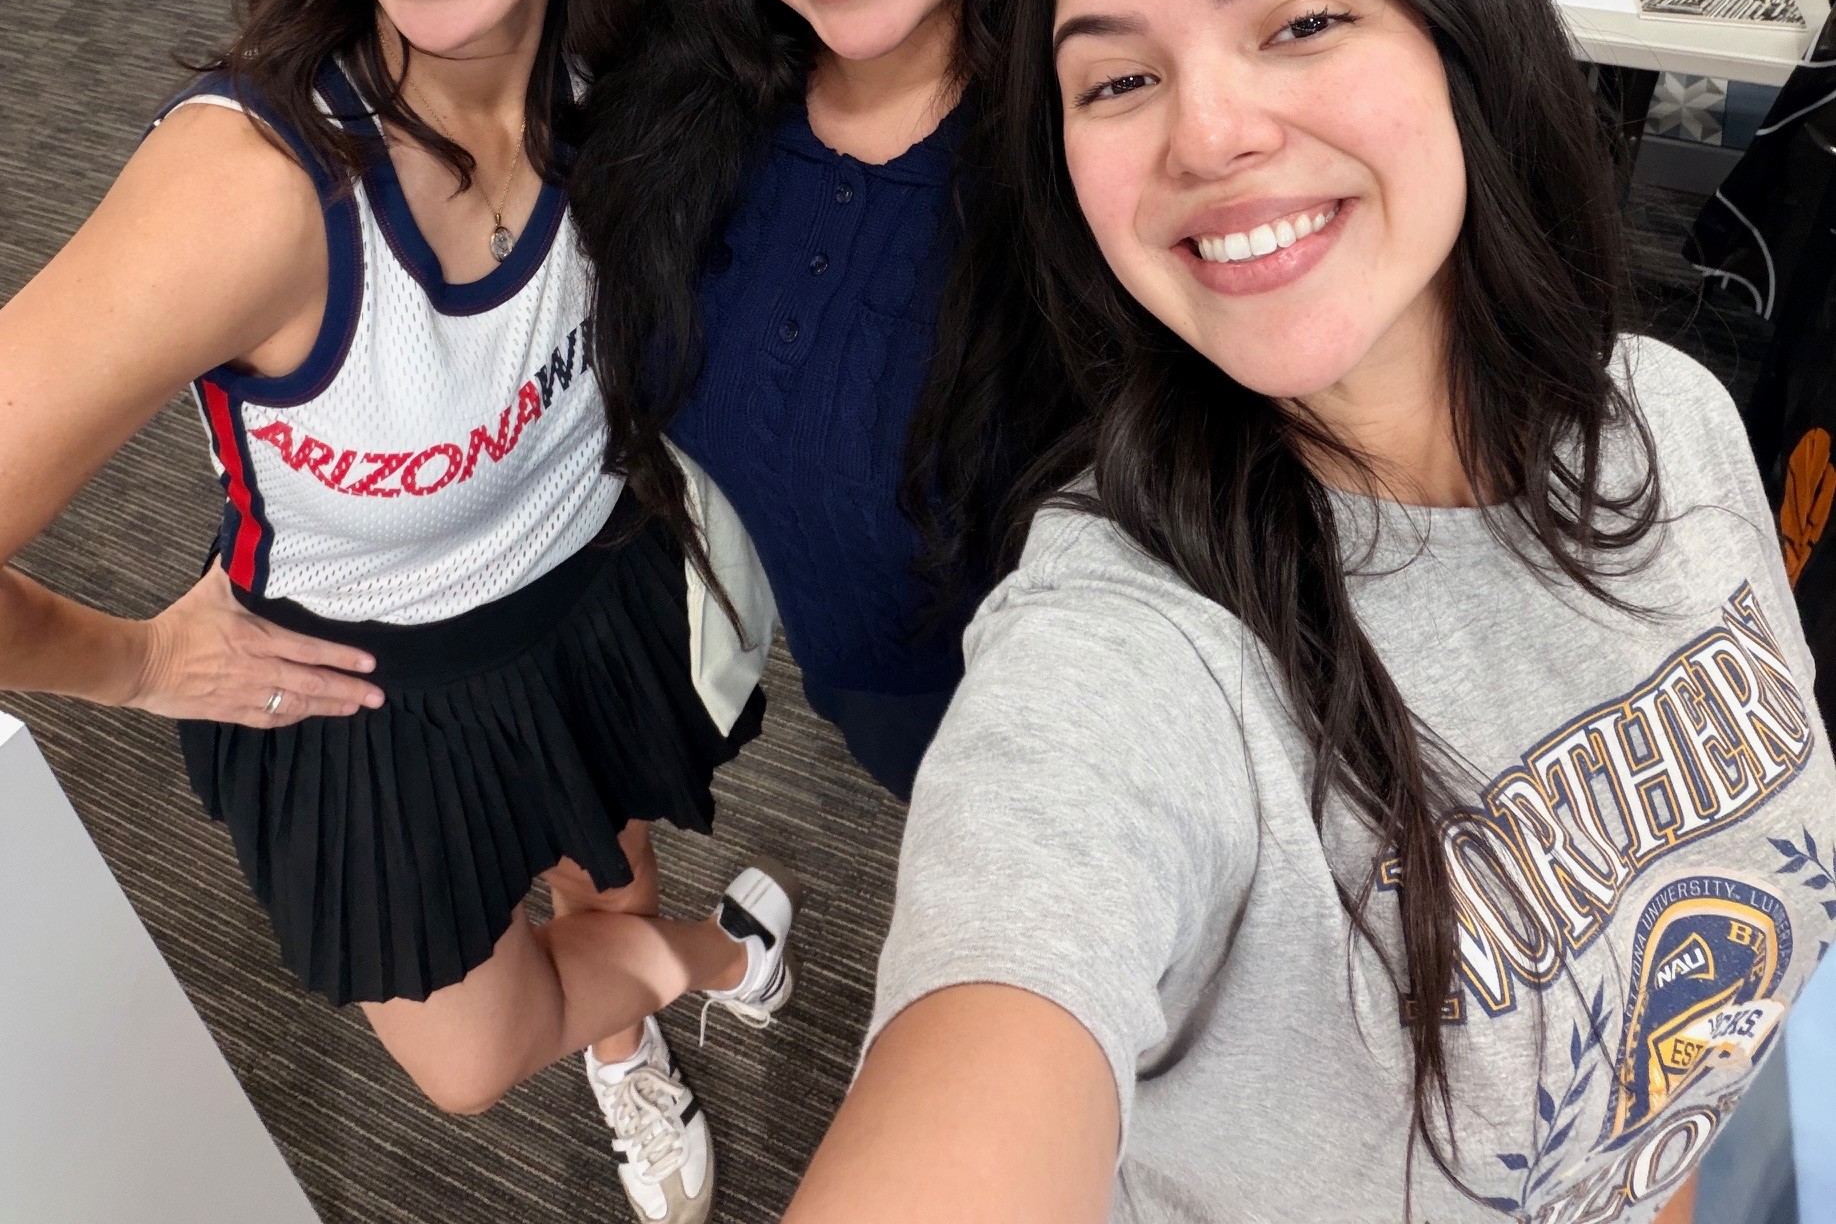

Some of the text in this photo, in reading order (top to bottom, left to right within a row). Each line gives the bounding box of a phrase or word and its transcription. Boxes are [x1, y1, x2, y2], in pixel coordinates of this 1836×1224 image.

[249, 379, 543, 498] ARIZONA
[1640, 880, 1735, 929] UNIVERSITY
[1656, 947, 1706, 989] NAU
